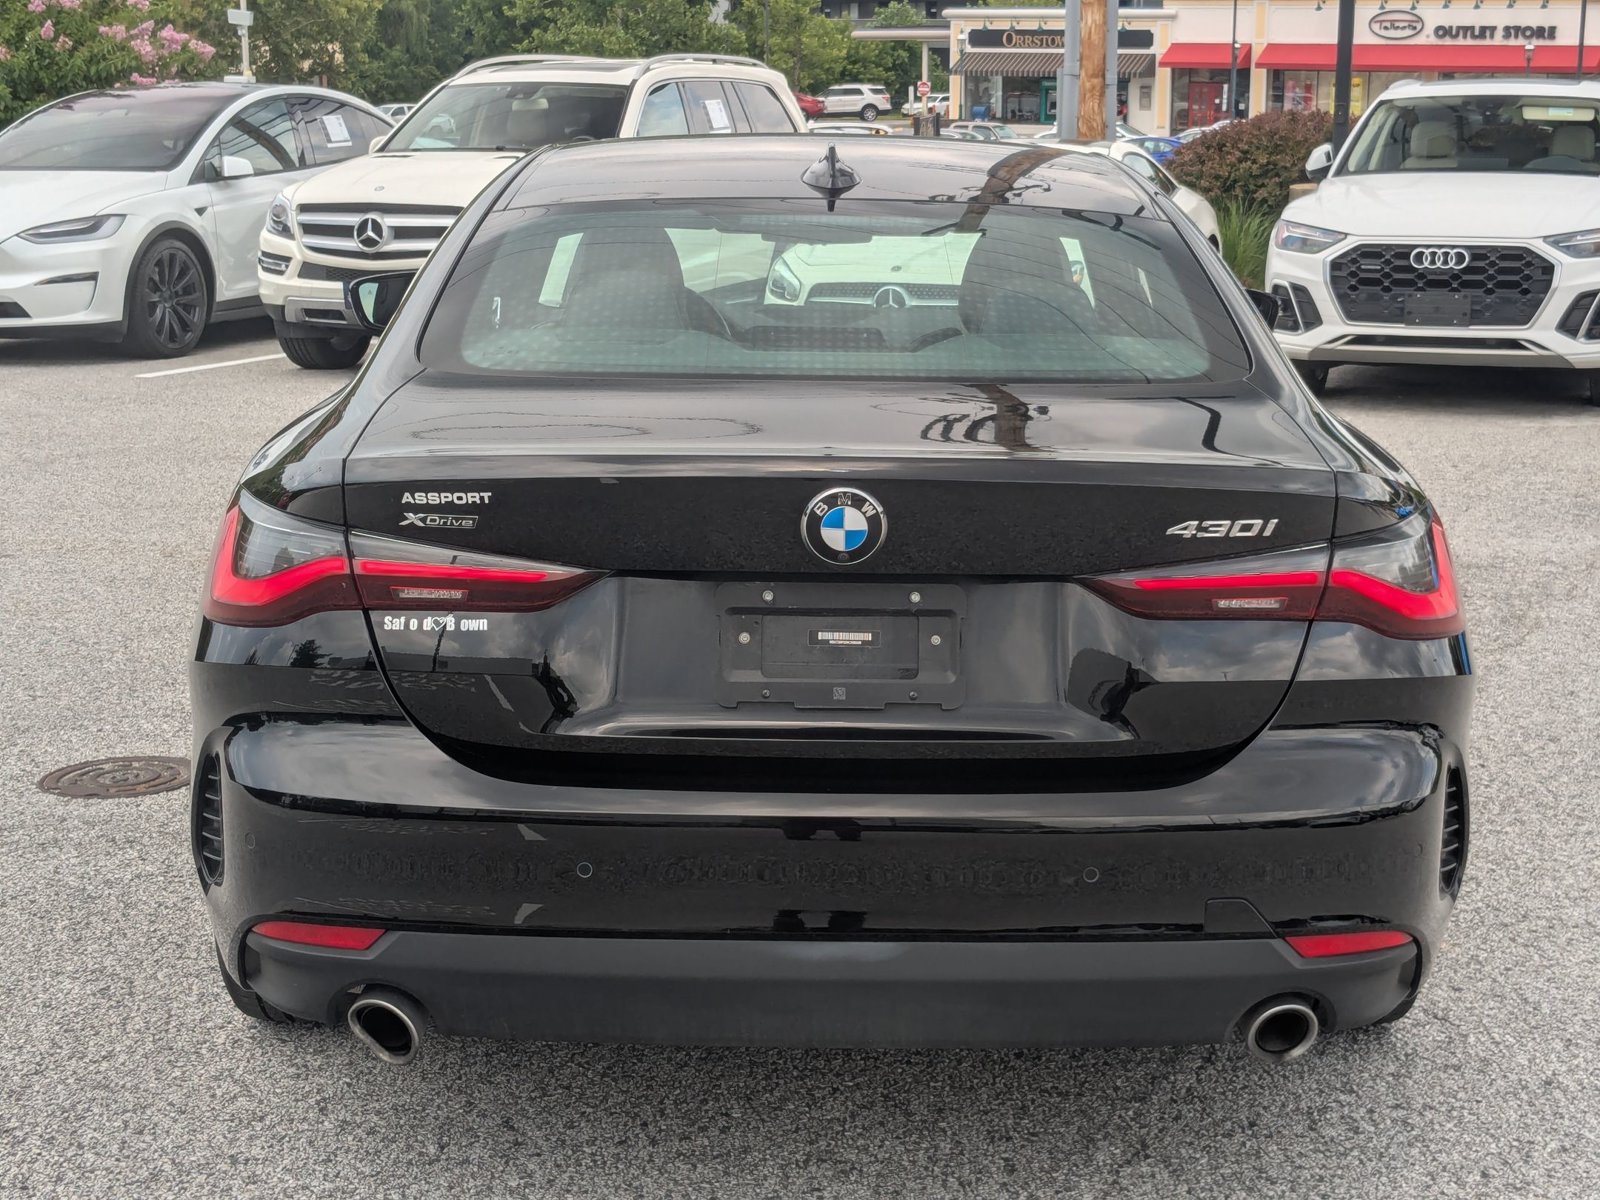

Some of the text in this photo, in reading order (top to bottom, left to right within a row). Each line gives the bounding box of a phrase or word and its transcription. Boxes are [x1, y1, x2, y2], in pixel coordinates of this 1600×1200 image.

[1433, 25, 1557, 40] OUTLET STORE
[401, 492, 492, 504] ASSPORT
[813, 492, 877, 518] BMW
